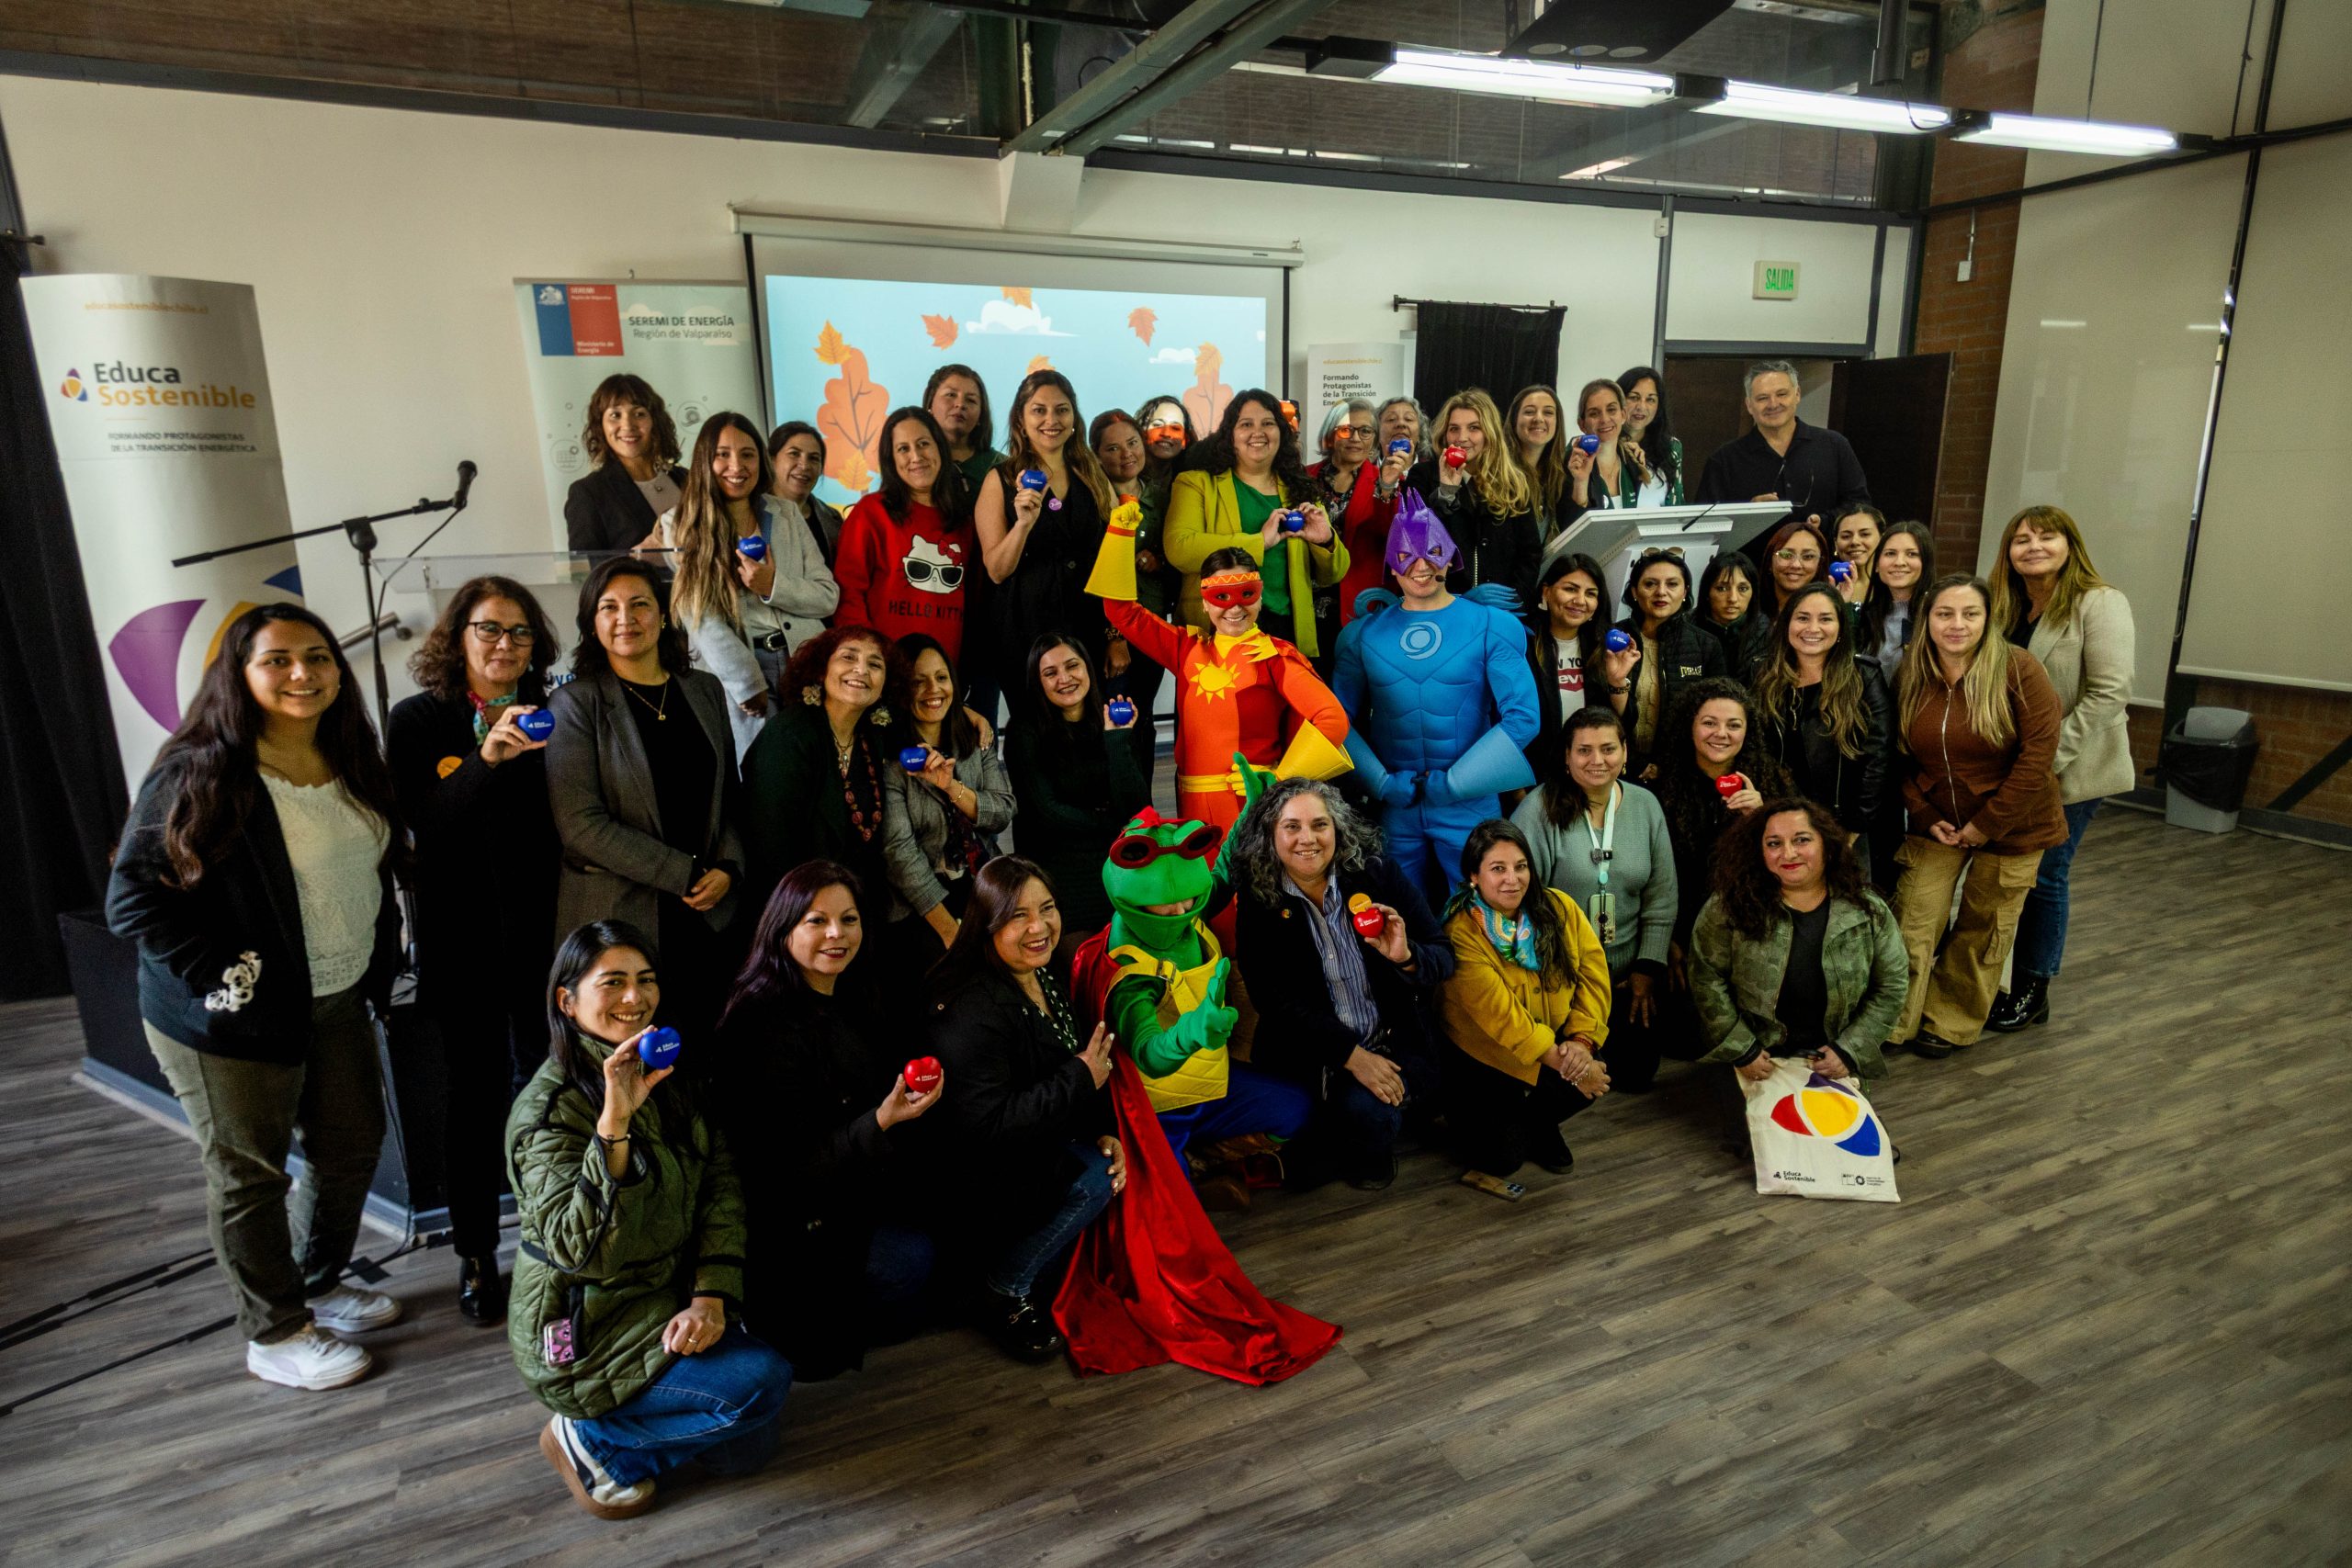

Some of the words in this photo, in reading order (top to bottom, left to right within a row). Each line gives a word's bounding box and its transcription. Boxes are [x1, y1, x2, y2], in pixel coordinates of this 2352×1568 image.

[1766, 268, 1793, 291] SALIDA
[628, 316, 669, 326] SEREMI
[672, 316, 686, 326] DE
[689, 315, 735, 326] ENERGÍA
[633, 329, 667, 340] Región
[669, 330, 682, 338] de
[94, 361, 182, 384] Educa
[1323, 382, 1372, 390] Protagonistas
[98, 385, 256, 409] Sostenible
[164, 433, 245, 441] PROTAGONISTAS
[198, 444, 257, 452] ENERGÉTICA
[888, 601, 933, 617] HELLO
